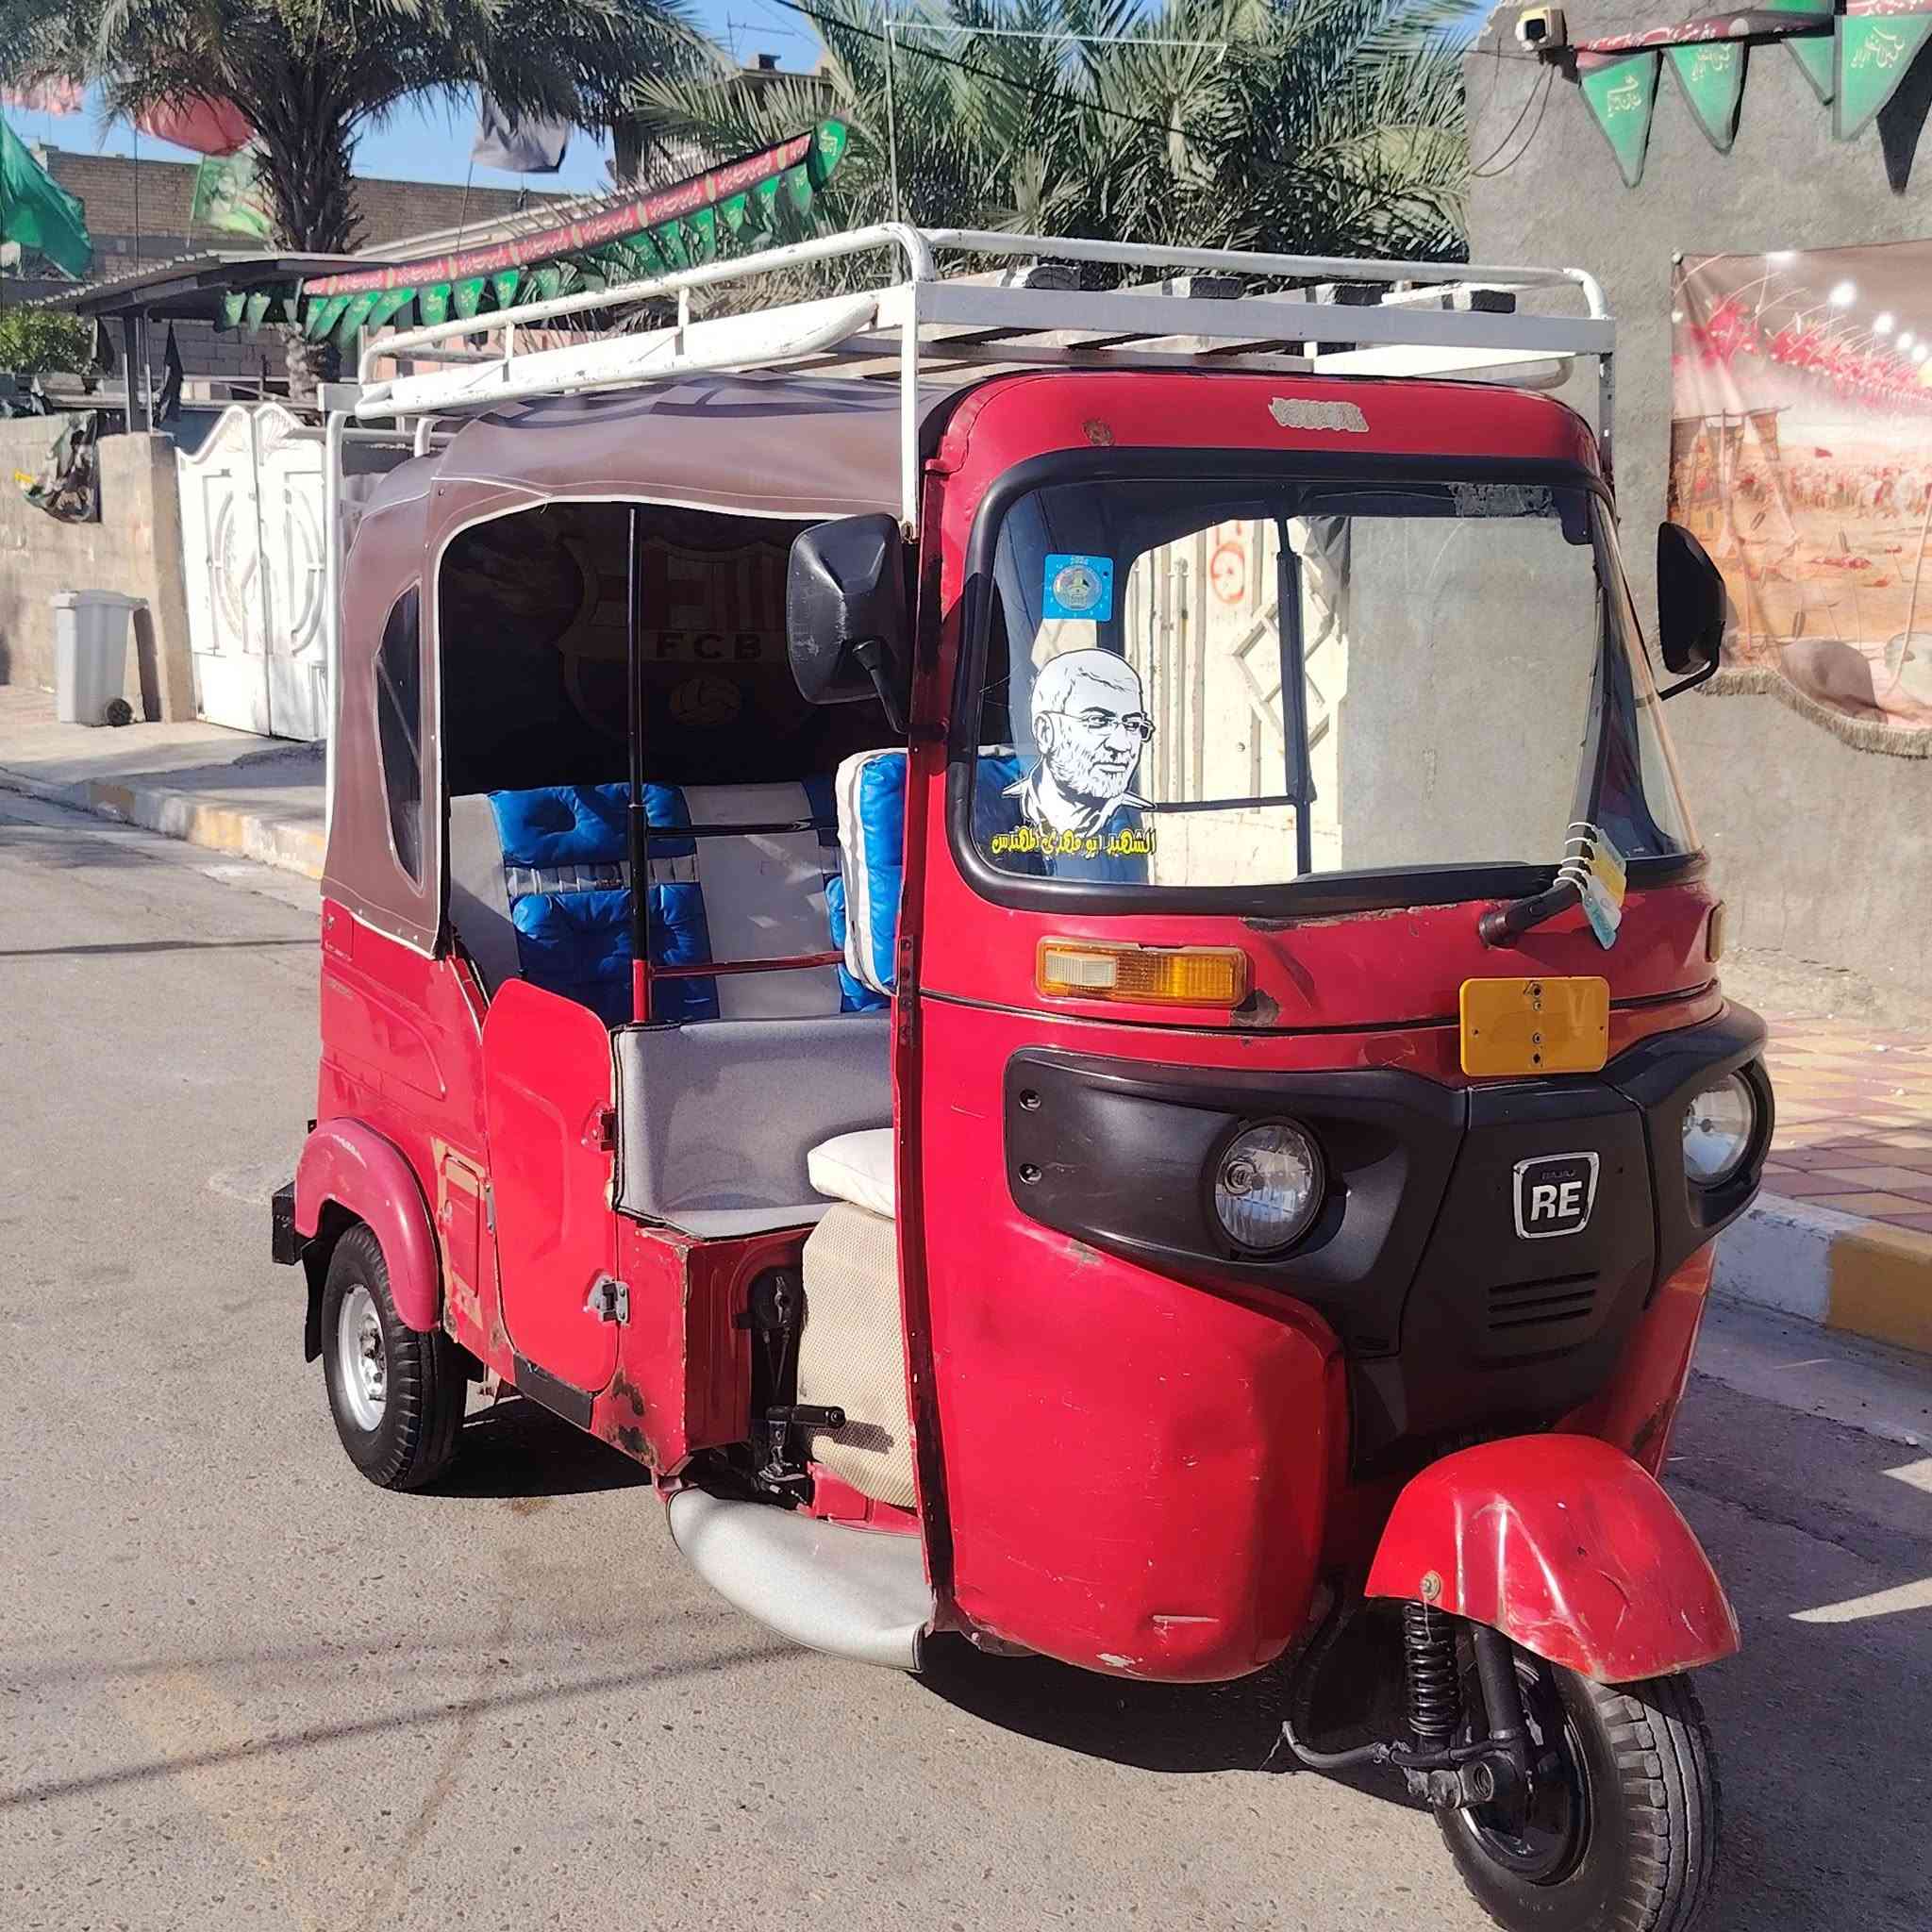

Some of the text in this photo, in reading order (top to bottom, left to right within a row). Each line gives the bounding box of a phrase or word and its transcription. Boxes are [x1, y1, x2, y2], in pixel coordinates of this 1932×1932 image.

[656, 633, 761, 658] FCB
[1106, 829, 1157, 858] الشهيد
[1531, 1181, 1583, 1222] RE
